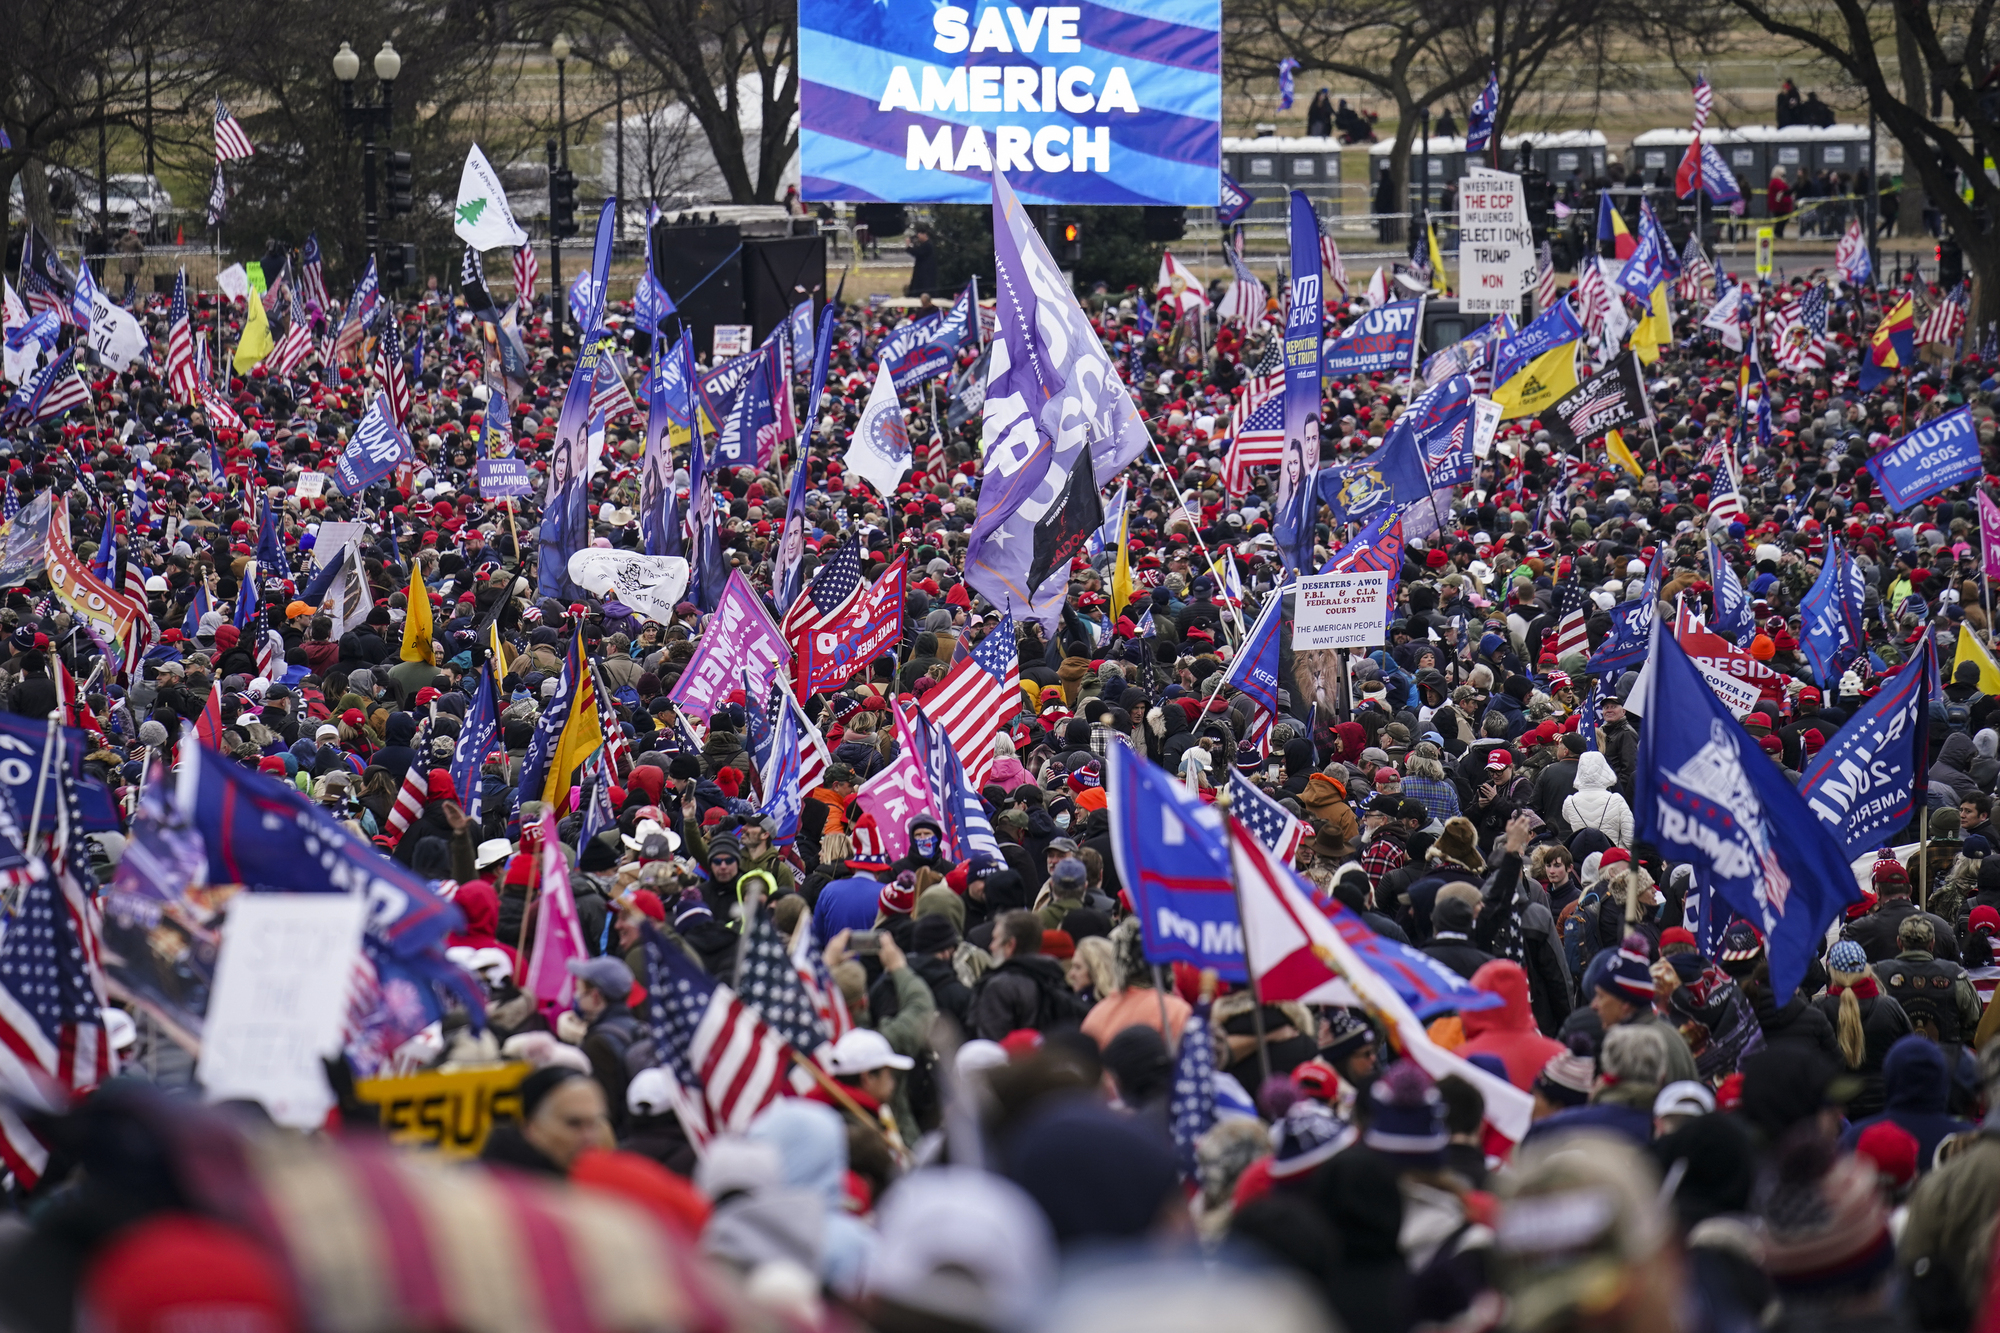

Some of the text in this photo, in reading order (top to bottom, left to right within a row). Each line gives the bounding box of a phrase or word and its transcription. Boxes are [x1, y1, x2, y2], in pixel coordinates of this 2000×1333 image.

[933, 6, 1081, 54] SAVE
[878, 65, 1140, 114] AMERICA
[906, 125, 1110, 173] MARCH
[1463, 181, 1514, 192] INVESTIGATE
[1465, 195, 1514, 209] THE CCP
[1465, 212, 1514, 223] INFLUENCED
[1474, 249, 1511, 263] TRUMP
[1481, 275, 1504, 288] WON
[1290, 274, 1319, 308] NTD
[1467, 300, 1514, 310] BIDEN LOST
[1289, 304, 1317, 329] NEWS
[1286, 336, 1318, 354] REPORTING
[1298, 351, 1318, 366] TRUTH
[489, 463, 516, 475] WATCH
[480, 475, 530, 487] UNPLANNED
[1302, 580, 1352, 590] DESERTERS
[1357, 578, 1383, 587] AWOL
[1304, 588, 1379, 599] F.B.I. & C.I.A.
[1306, 598, 1342, 607] FEDERAL
[1351, 595, 1376, 604] STATE
[1325, 606, 1357, 615] COURTS
[1296, 620, 1383, 633] THE AMERICAN PEOPLE
[1312, 634, 1366, 645] WANT JUSTICE
[1705, 675, 1740, 696] COVER
[1740, 691, 1754, 701] IT
[1657, 794, 1752, 880] TRUMP
[1157, 907, 1199, 949] NO
